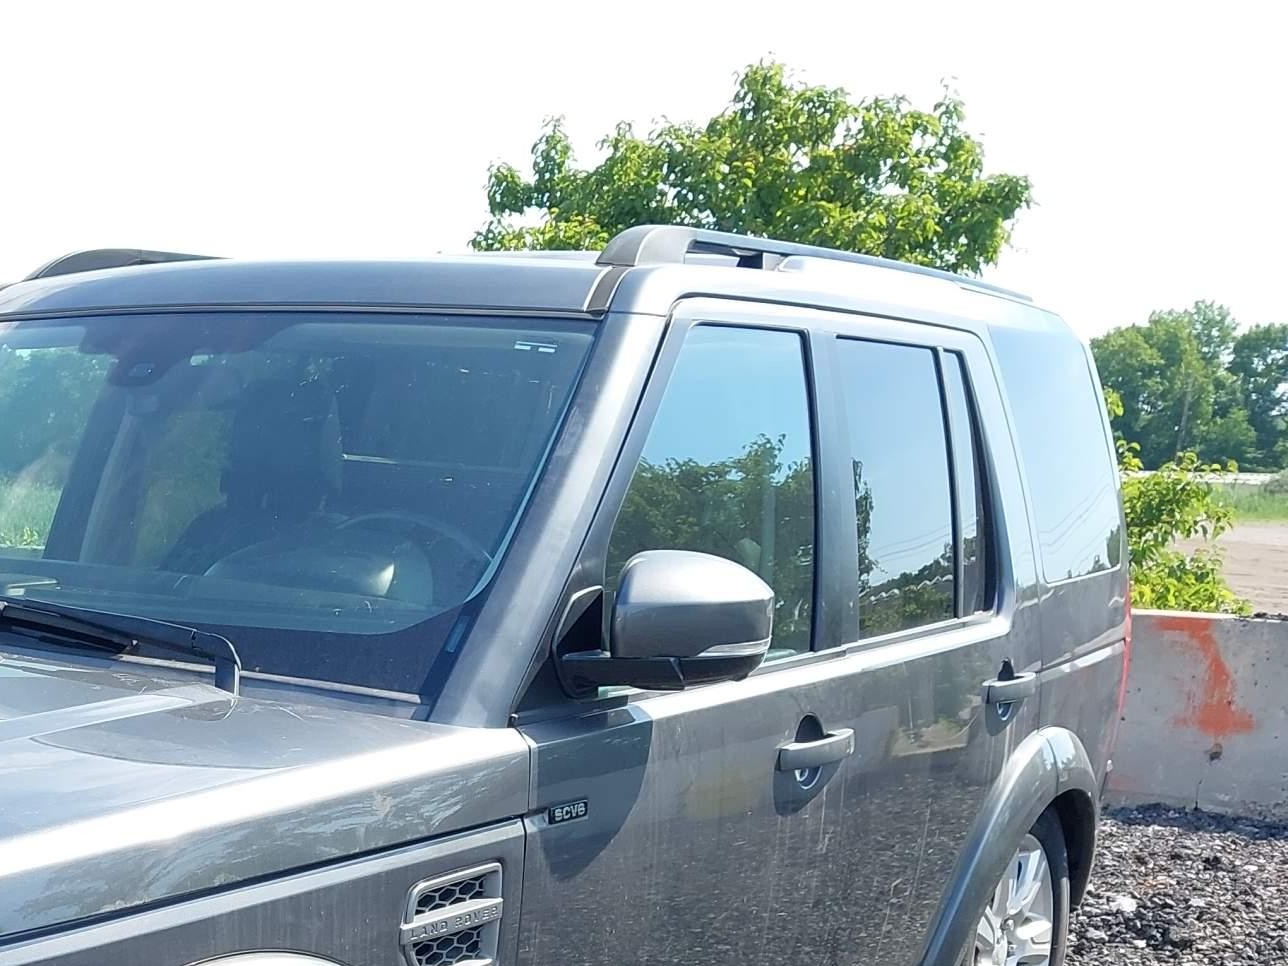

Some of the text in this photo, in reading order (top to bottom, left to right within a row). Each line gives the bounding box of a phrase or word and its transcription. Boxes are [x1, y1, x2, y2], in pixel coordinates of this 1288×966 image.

[554, 802, 586, 822] SCV6
[410, 905, 499, 941] LAND ROVER
